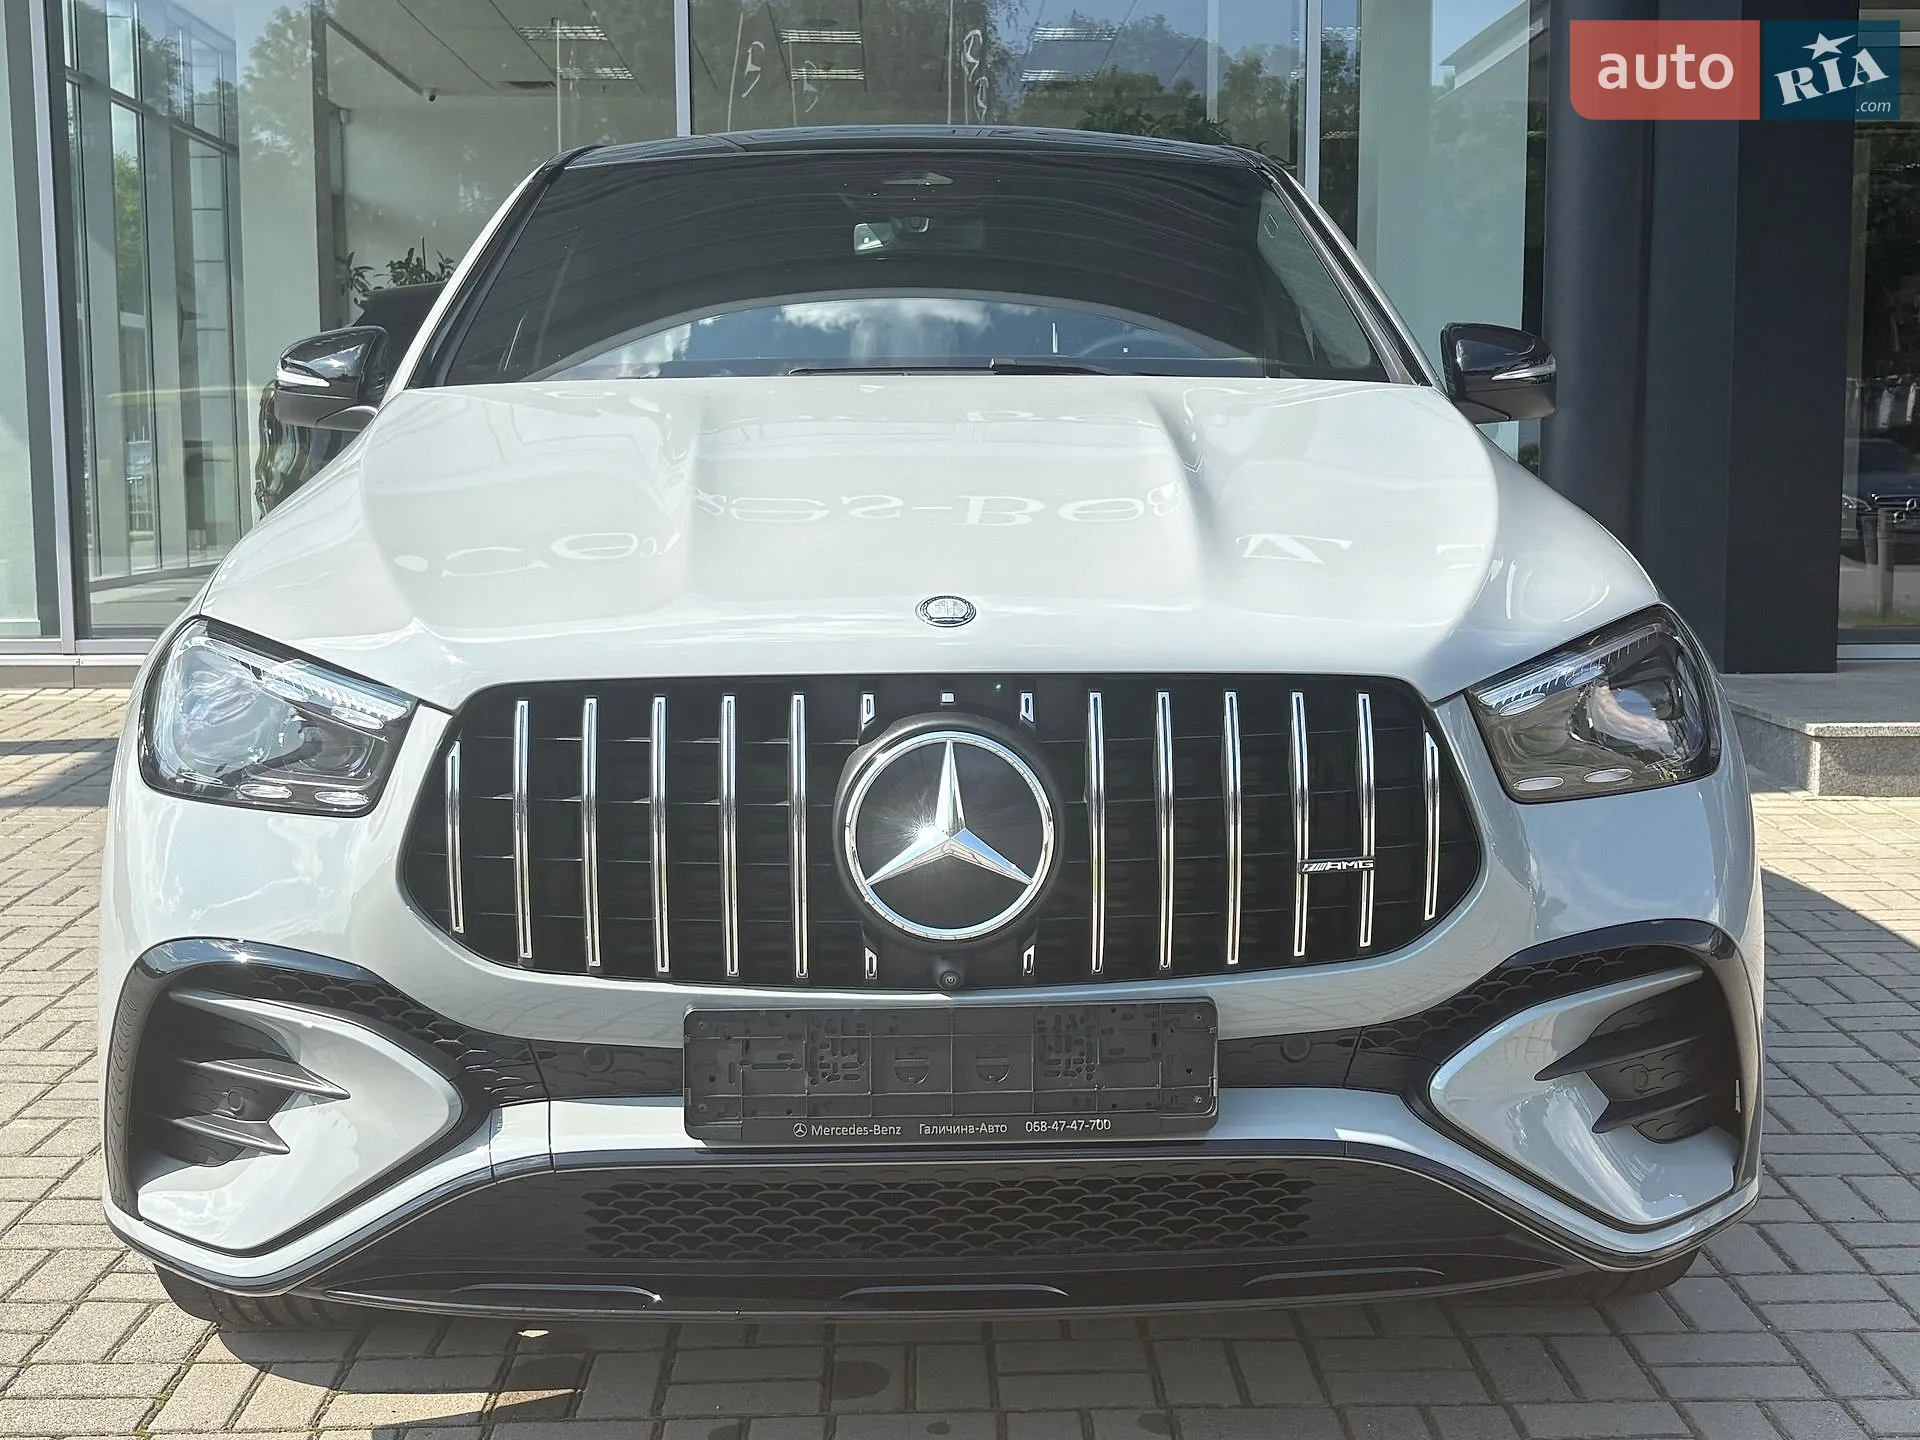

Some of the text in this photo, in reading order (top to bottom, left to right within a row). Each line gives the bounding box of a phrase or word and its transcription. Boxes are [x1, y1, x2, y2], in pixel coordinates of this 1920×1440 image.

[1325, 859, 1374, 871] AMG
[811, 1118, 1112, 1136] Mercedes-Benz Галичина-Авто 068-47-47-700
